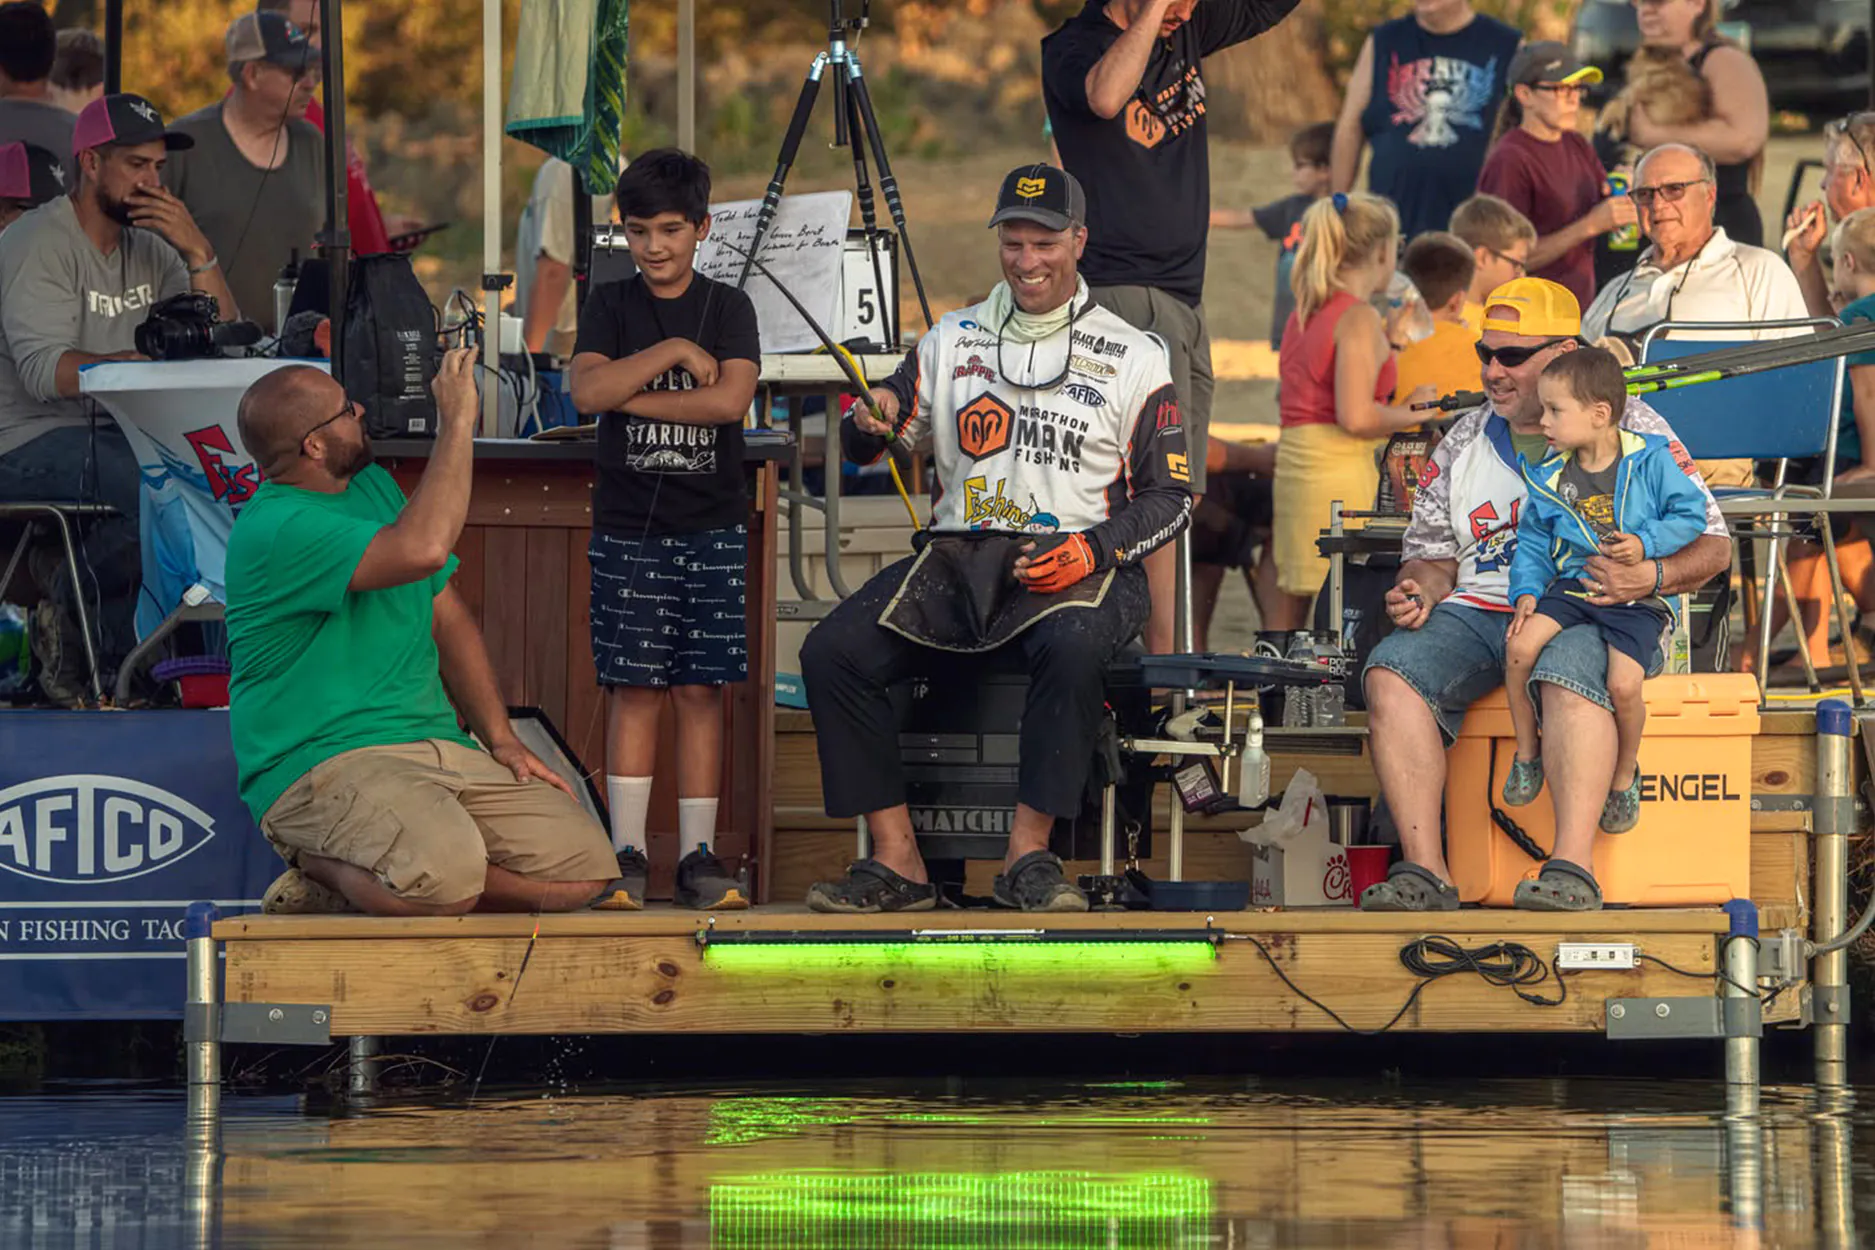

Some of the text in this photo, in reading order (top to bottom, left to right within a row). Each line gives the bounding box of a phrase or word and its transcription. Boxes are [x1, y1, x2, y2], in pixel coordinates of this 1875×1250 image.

[858, 288, 875, 325] 5
[1020, 405, 1089, 433] MARATHON
[1017, 419, 1085, 459] MAN
[182, 424, 264, 506] Fis
[1014, 449, 1080, 474] FISHNG
[1639, 774, 1741, 801] ENGEL
[0, 778, 190, 877] AFTCO
[19, 919, 130, 941] FISHING
